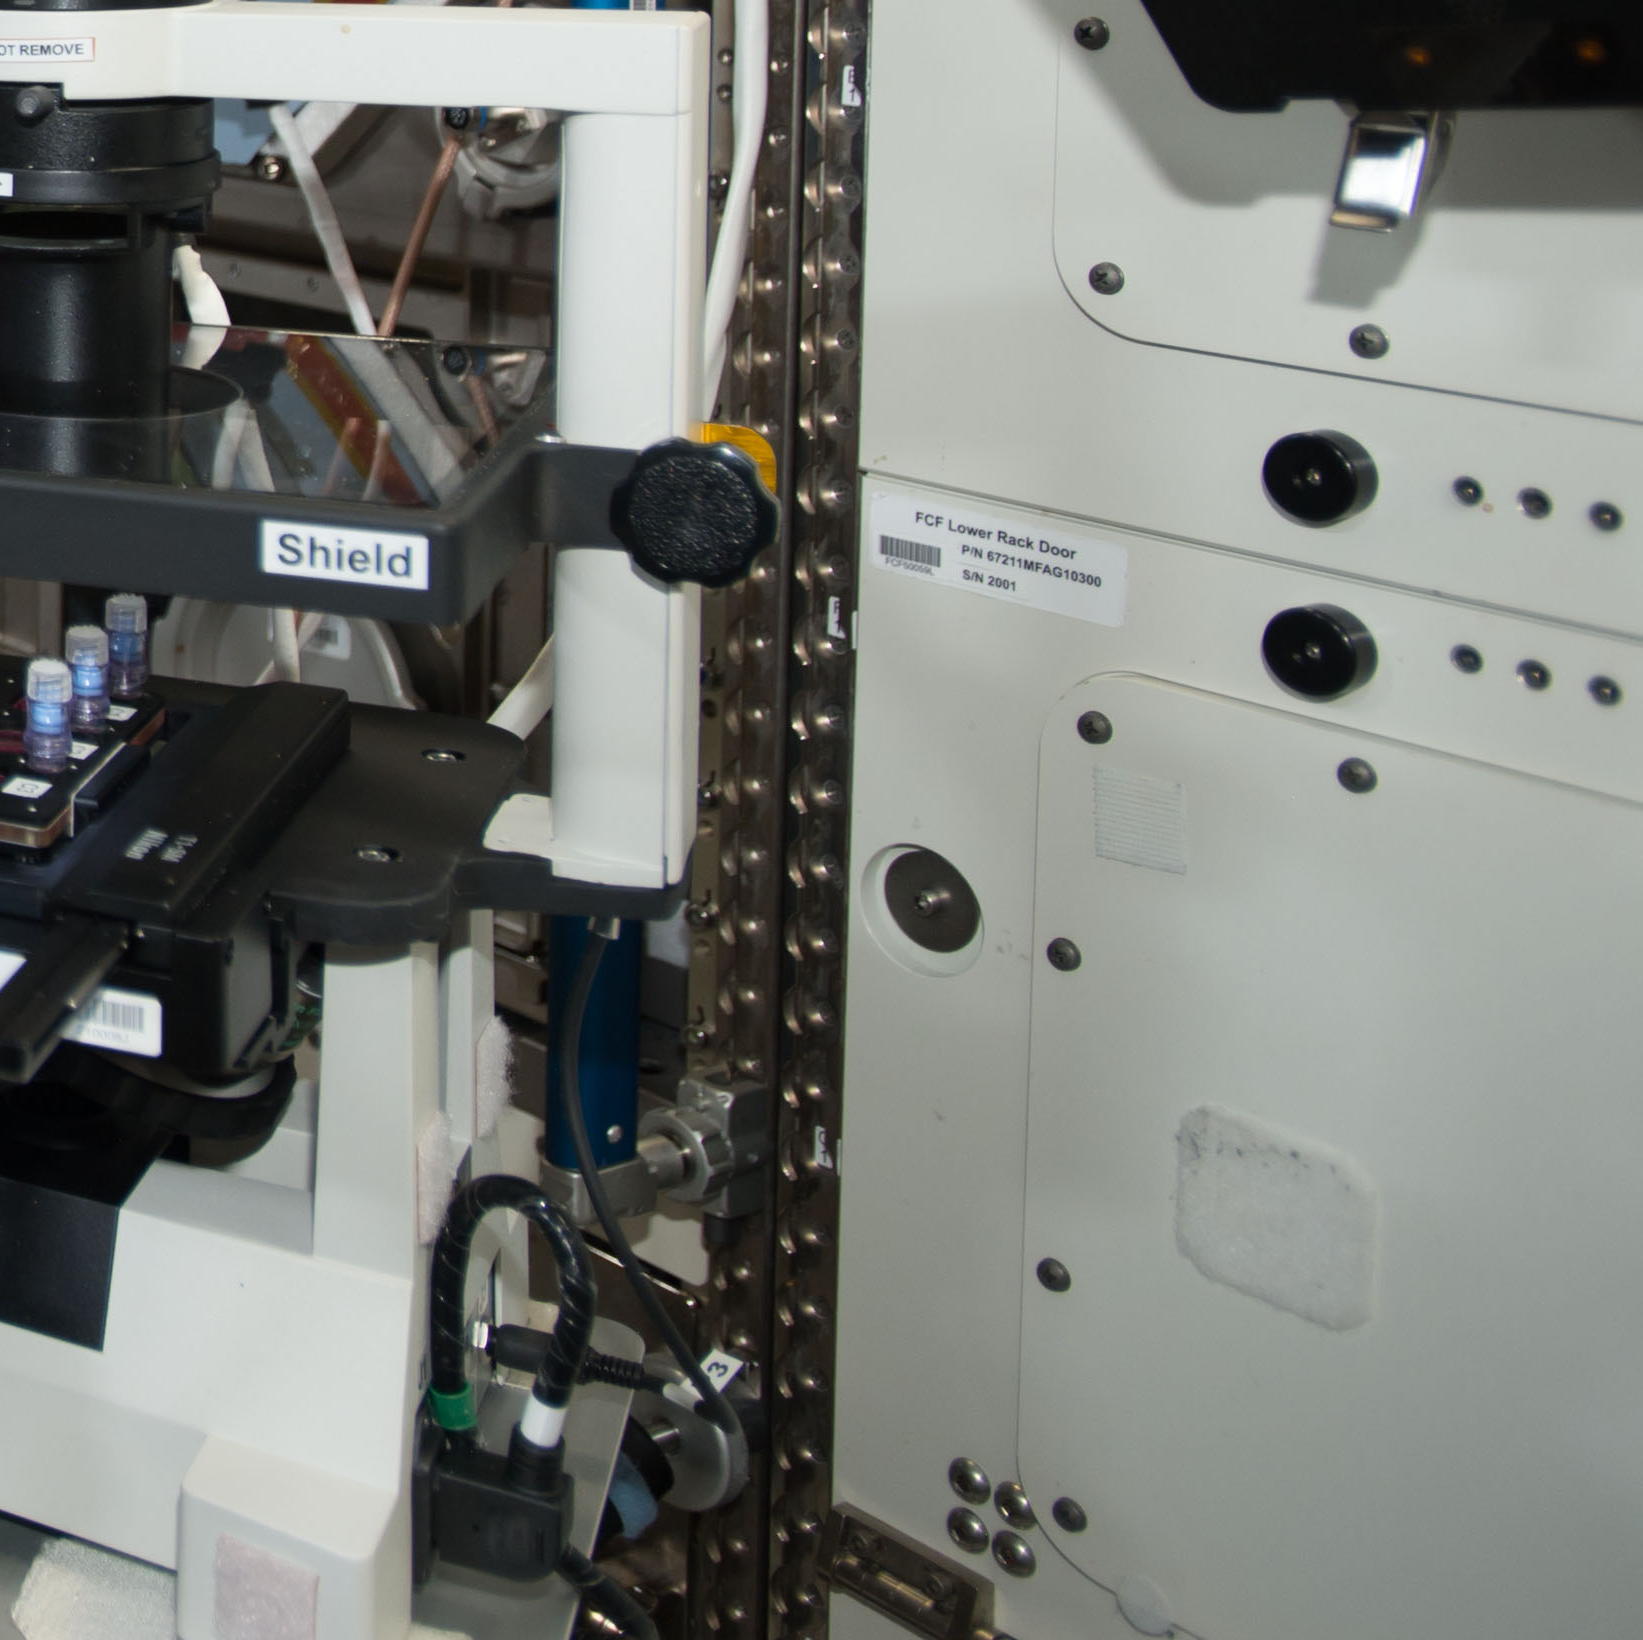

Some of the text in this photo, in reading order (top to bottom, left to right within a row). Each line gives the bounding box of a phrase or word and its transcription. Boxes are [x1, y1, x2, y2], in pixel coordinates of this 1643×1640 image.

[19, 43, 84, 56] REMOVE
[915, 511, 1078, 560] FCF Lower Rack Door
[277, 532, 413, 578] Shield
[961, 544, 1102, 588] P/N 67211MFAG10300
[962, 568, 1017, 592] S/N 2001
[707, 1361, 729, 1378] 3
